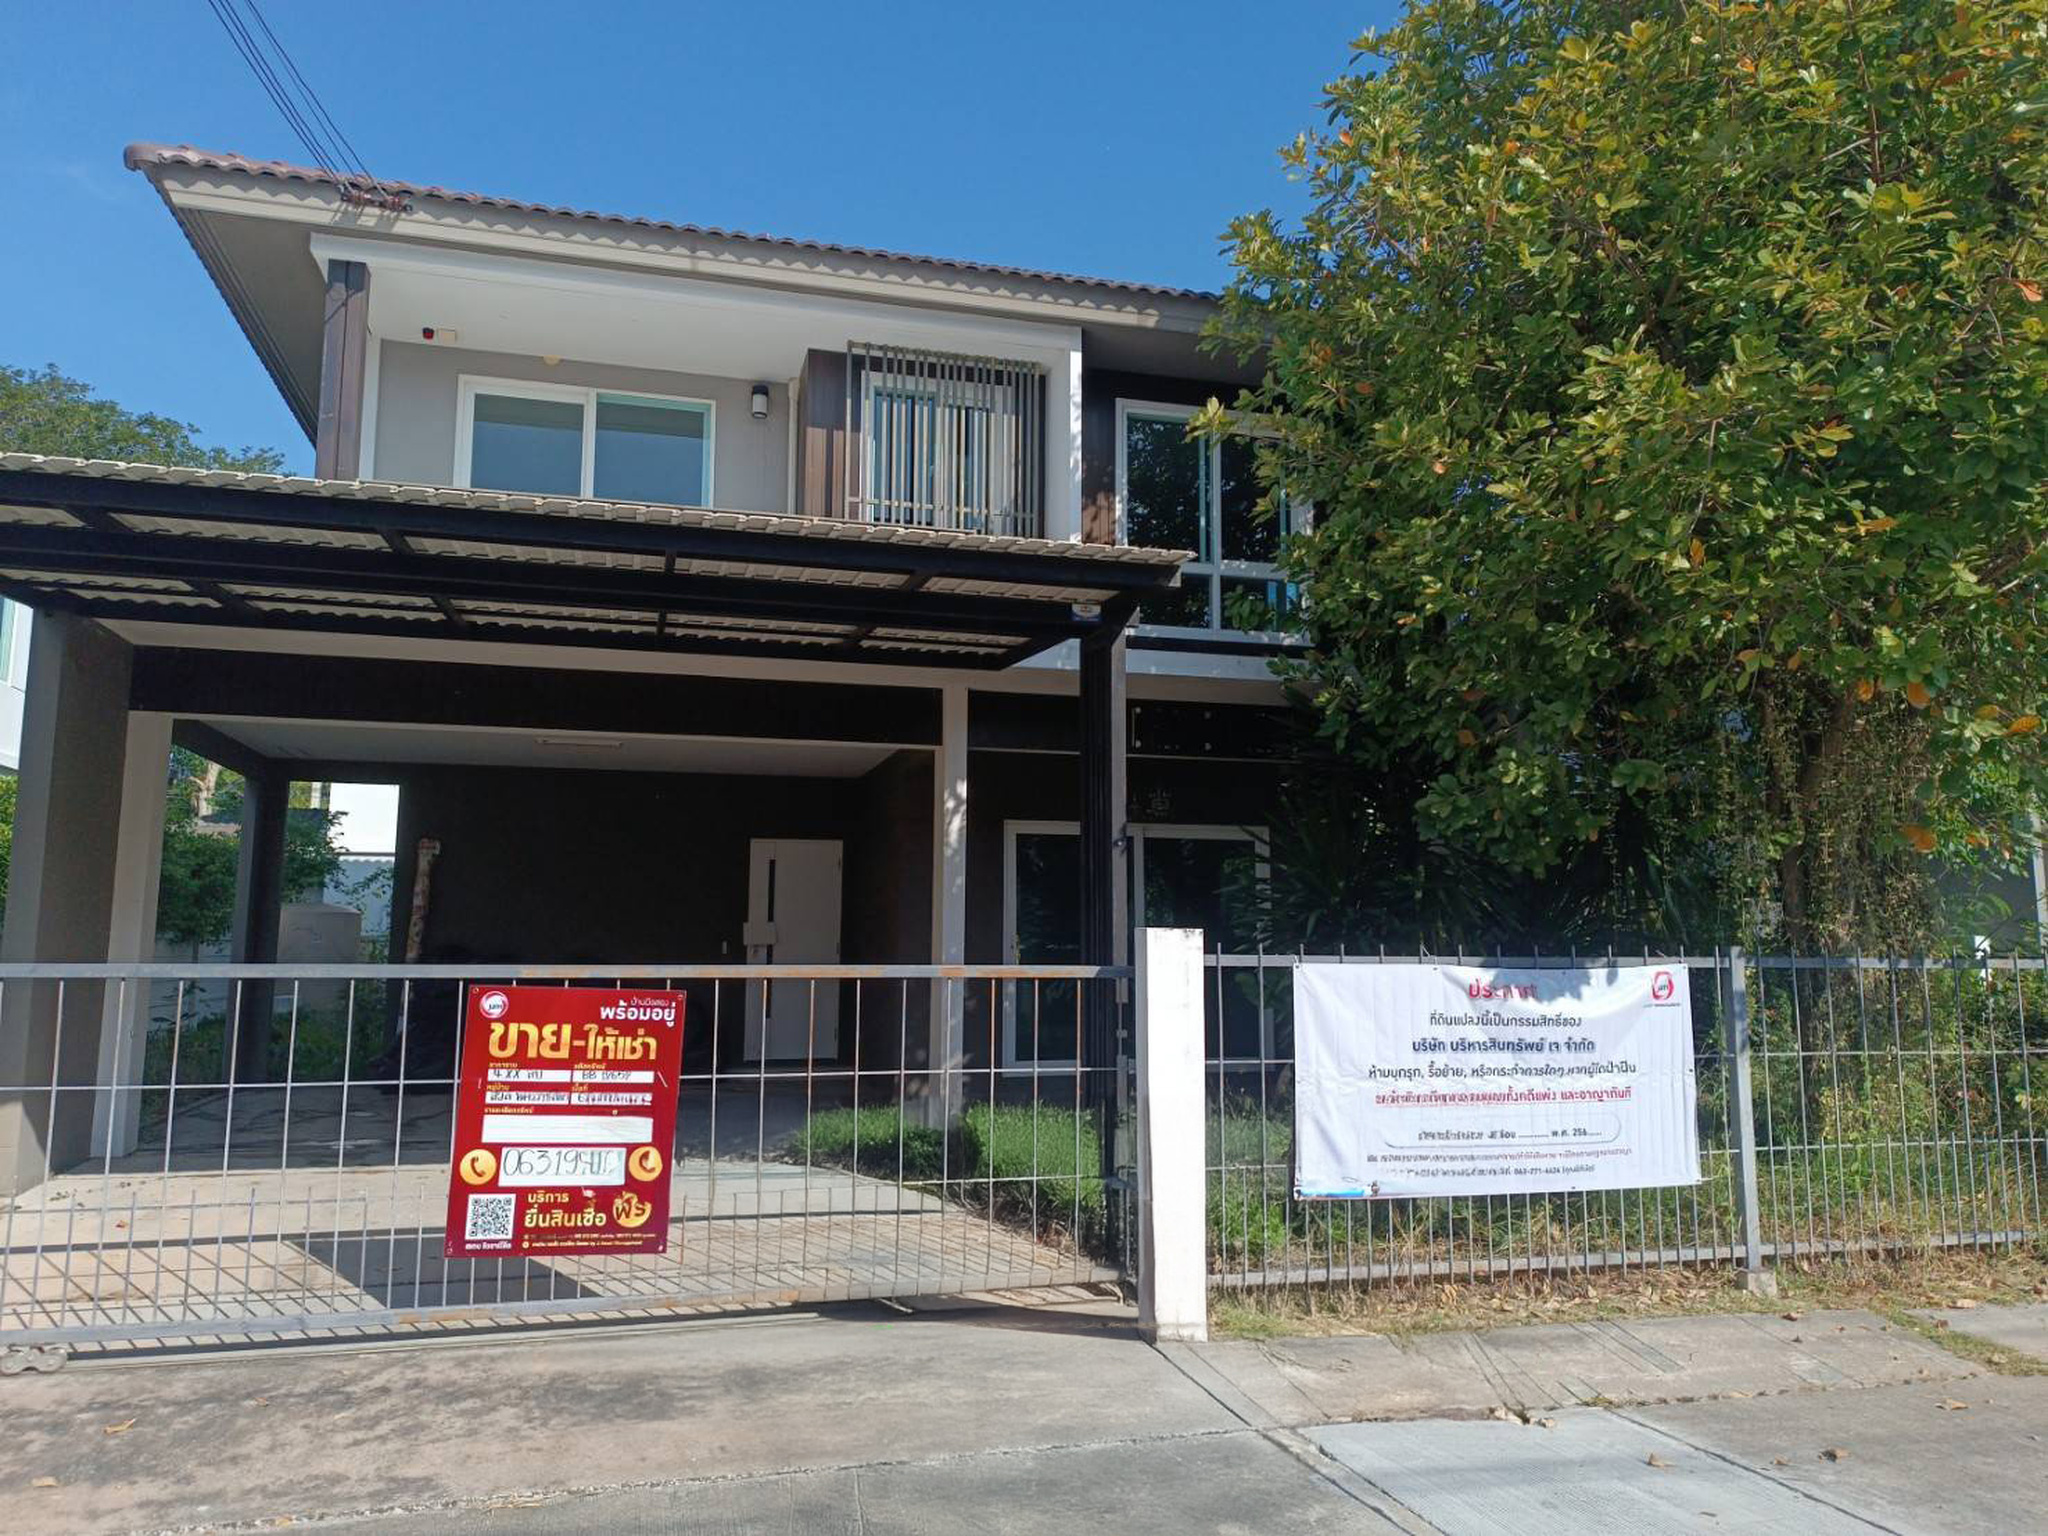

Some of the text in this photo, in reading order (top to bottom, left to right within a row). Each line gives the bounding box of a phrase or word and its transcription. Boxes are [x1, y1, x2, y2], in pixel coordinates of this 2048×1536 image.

[600, 1000, 676, 1027] พร้อมอยู่
[1412, 1036, 1446, 1052] บริษัท
[1450, 1036, 1544, 1053] บริหารสินทรัพย์
[1564, 1038, 1595, 1051] จำกัด
[527, 1190, 569, 1203] บริการ
